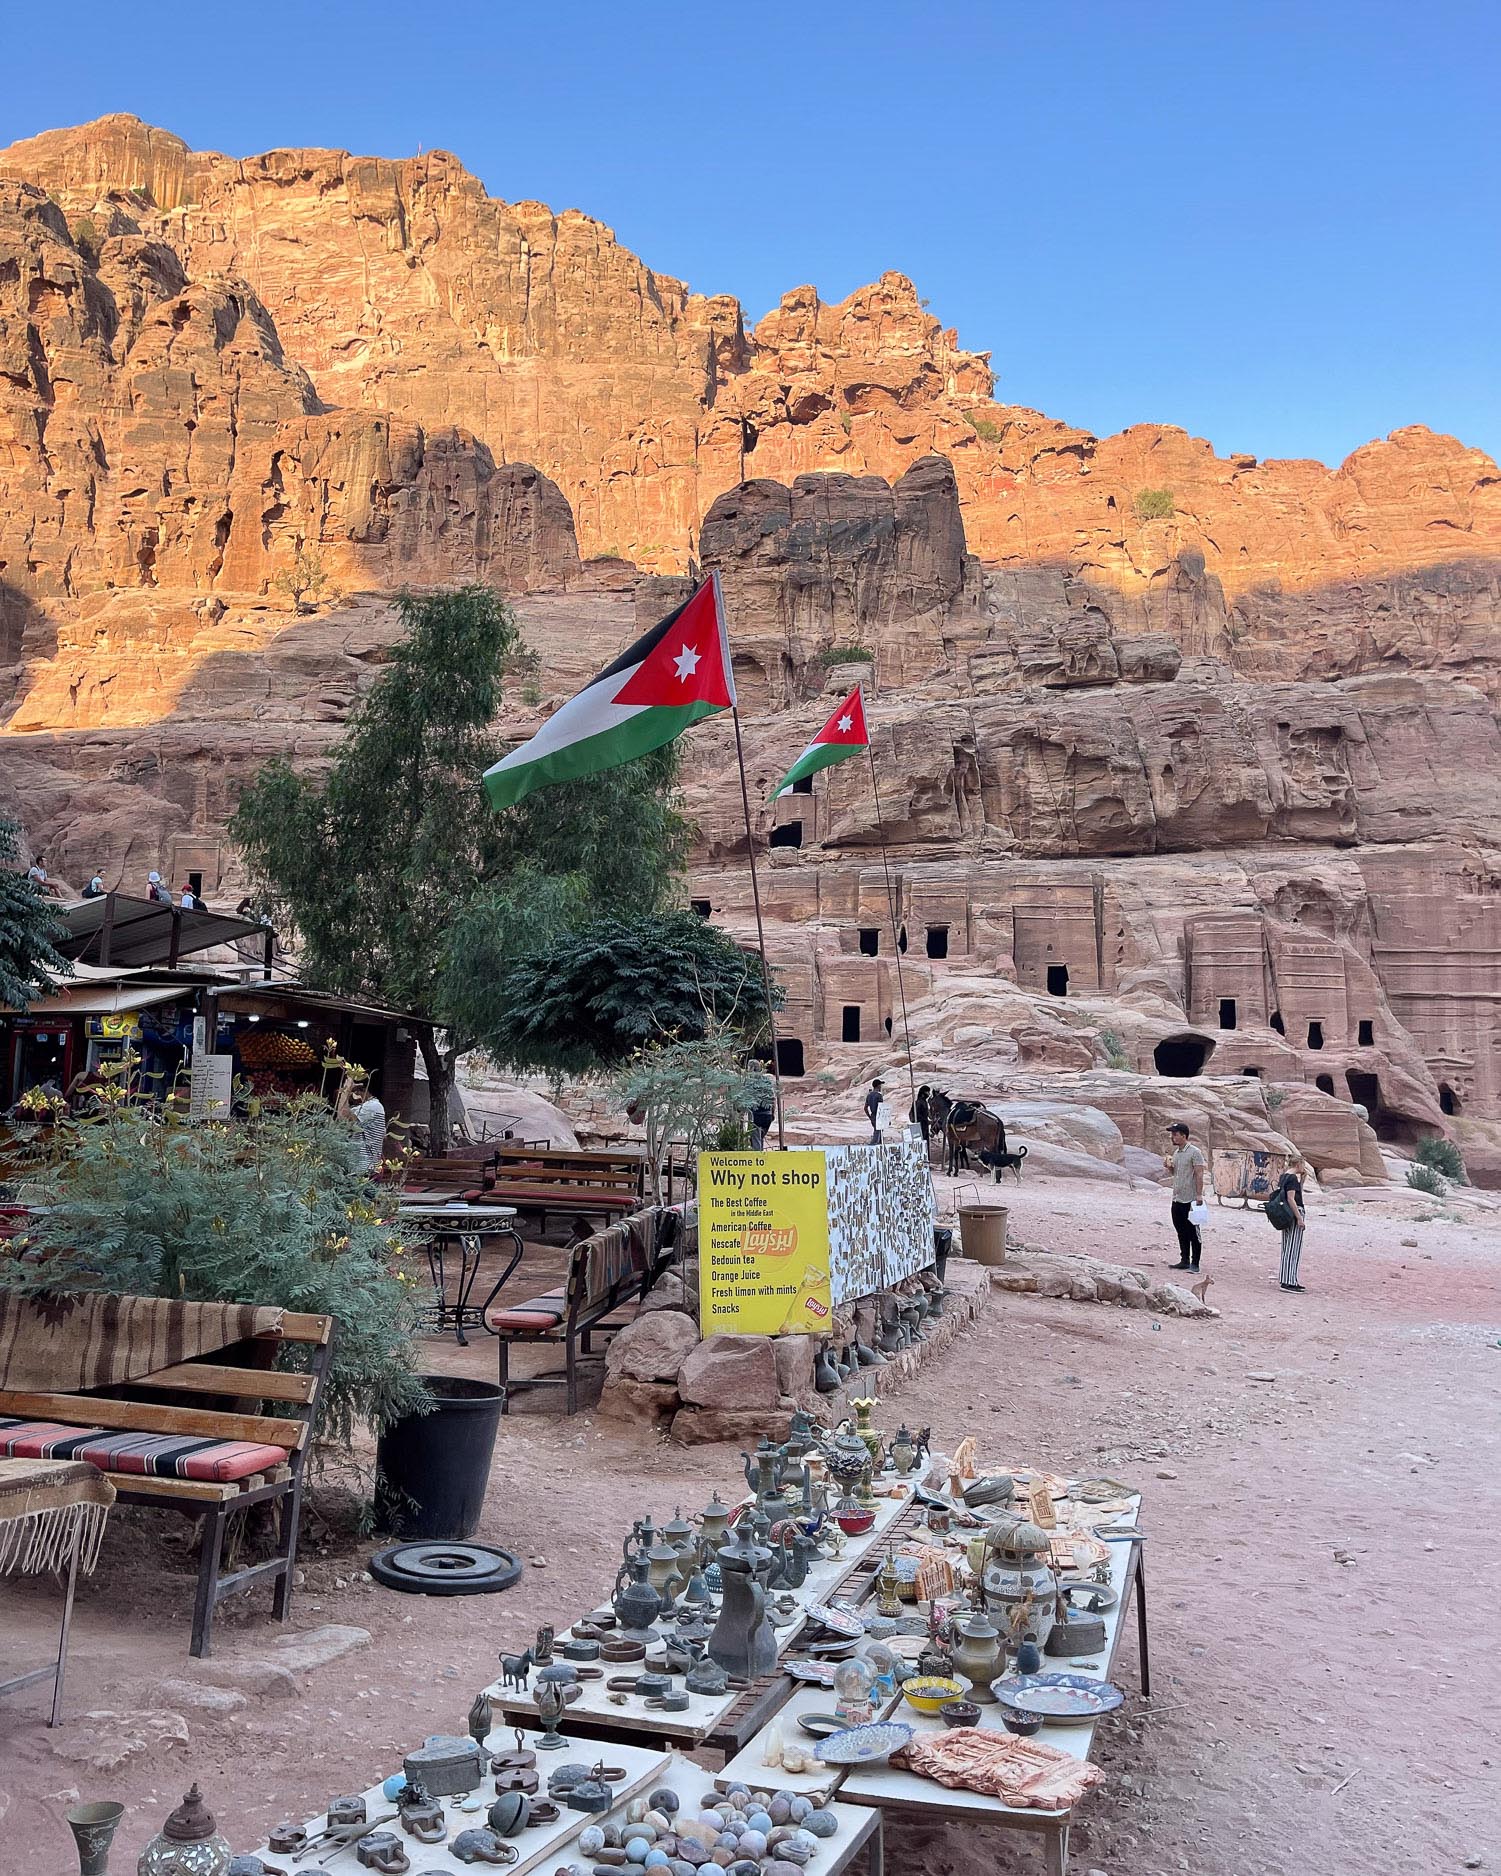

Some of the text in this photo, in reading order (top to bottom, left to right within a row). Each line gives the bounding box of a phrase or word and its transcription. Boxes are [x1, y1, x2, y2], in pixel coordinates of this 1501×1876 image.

[711, 1157, 764, 1166] Welcome to
[711, 1169, 820, 1189] Why not shop
[711, 1197, 767, 1207] The Best Coffee
[711, 1221, 772, 1232] American Coffee
[711, 1238, 741, 1249] Nescafe
[743, 1230, 776, 1254] Lay's
[711, 1255, 755, 1265] Bedouin tea
[711, 1270, 761, 1282] Orange Juice
[711, 1284, 797, 1297] Fresh limon with mints
[711, 1303, 740, 1314] Snacks
